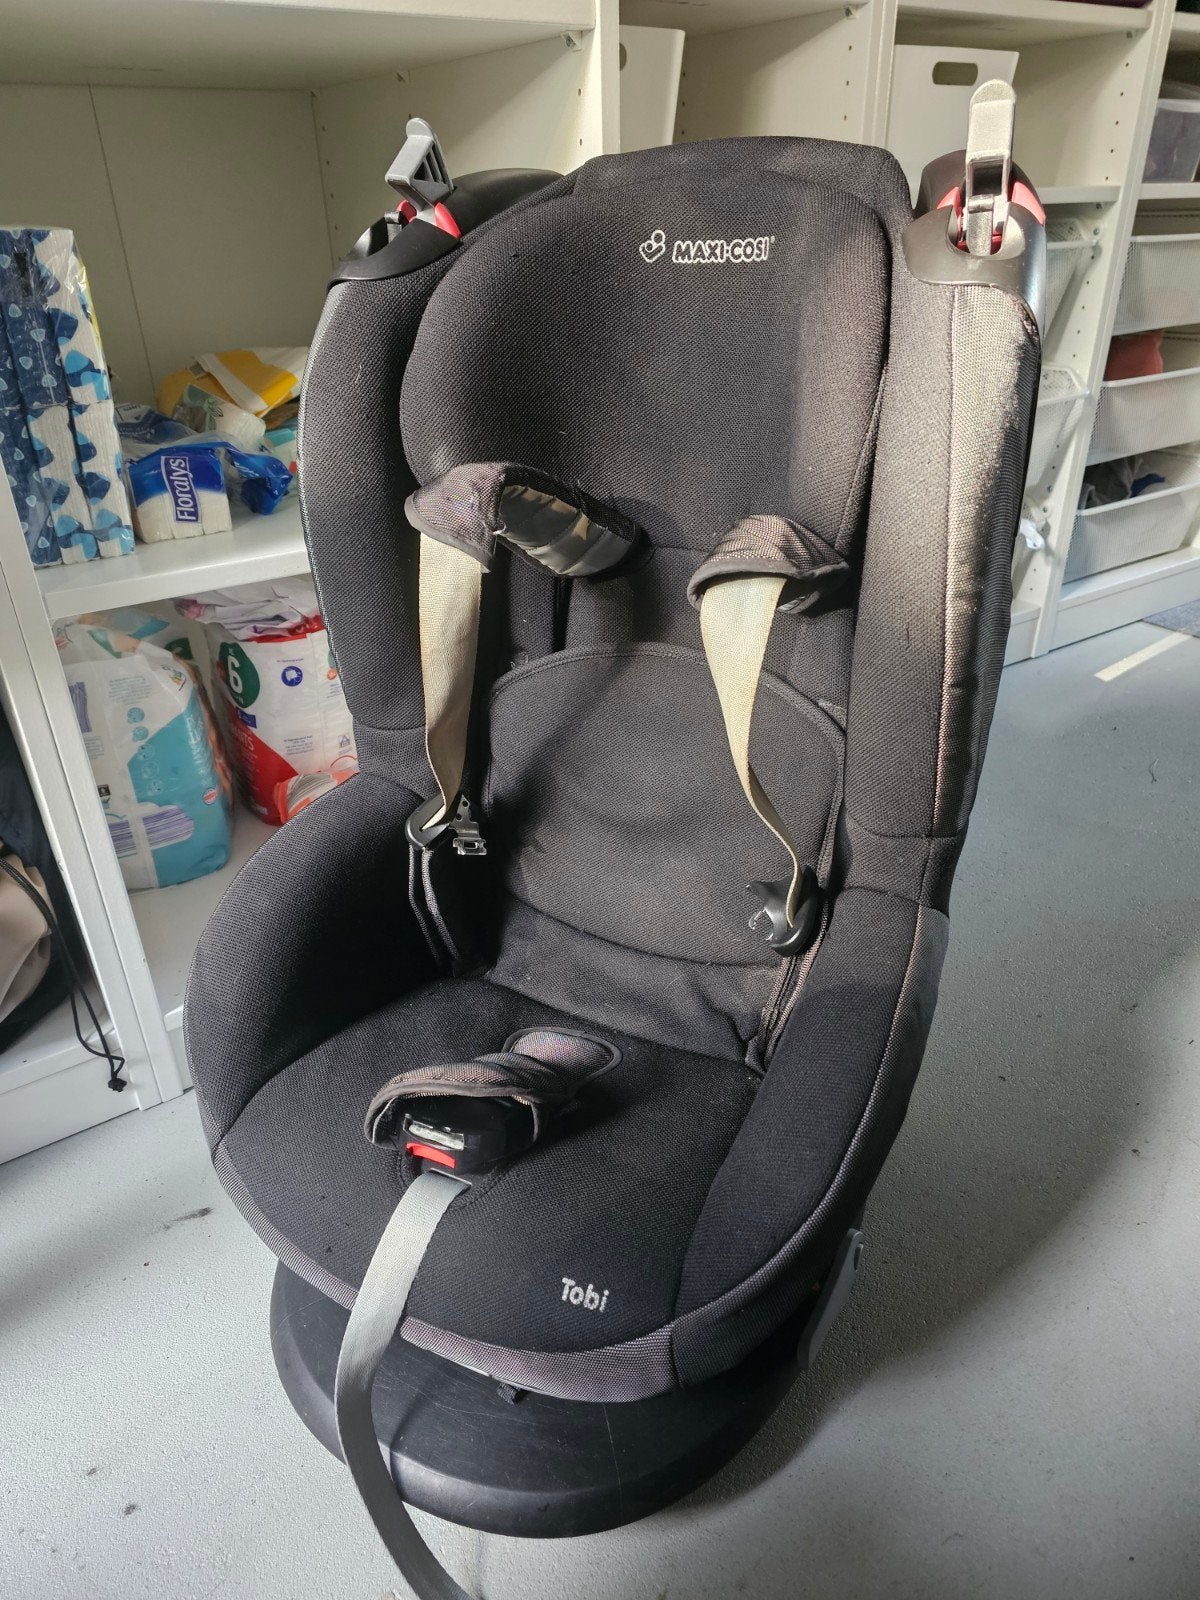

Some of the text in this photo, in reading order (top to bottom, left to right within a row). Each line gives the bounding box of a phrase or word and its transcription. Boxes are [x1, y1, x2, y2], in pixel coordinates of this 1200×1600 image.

[169, 458, 197, 520] Floralys
[227, 655, 243, 694] 6
[561, 1277, 610, 1313] Tobi
